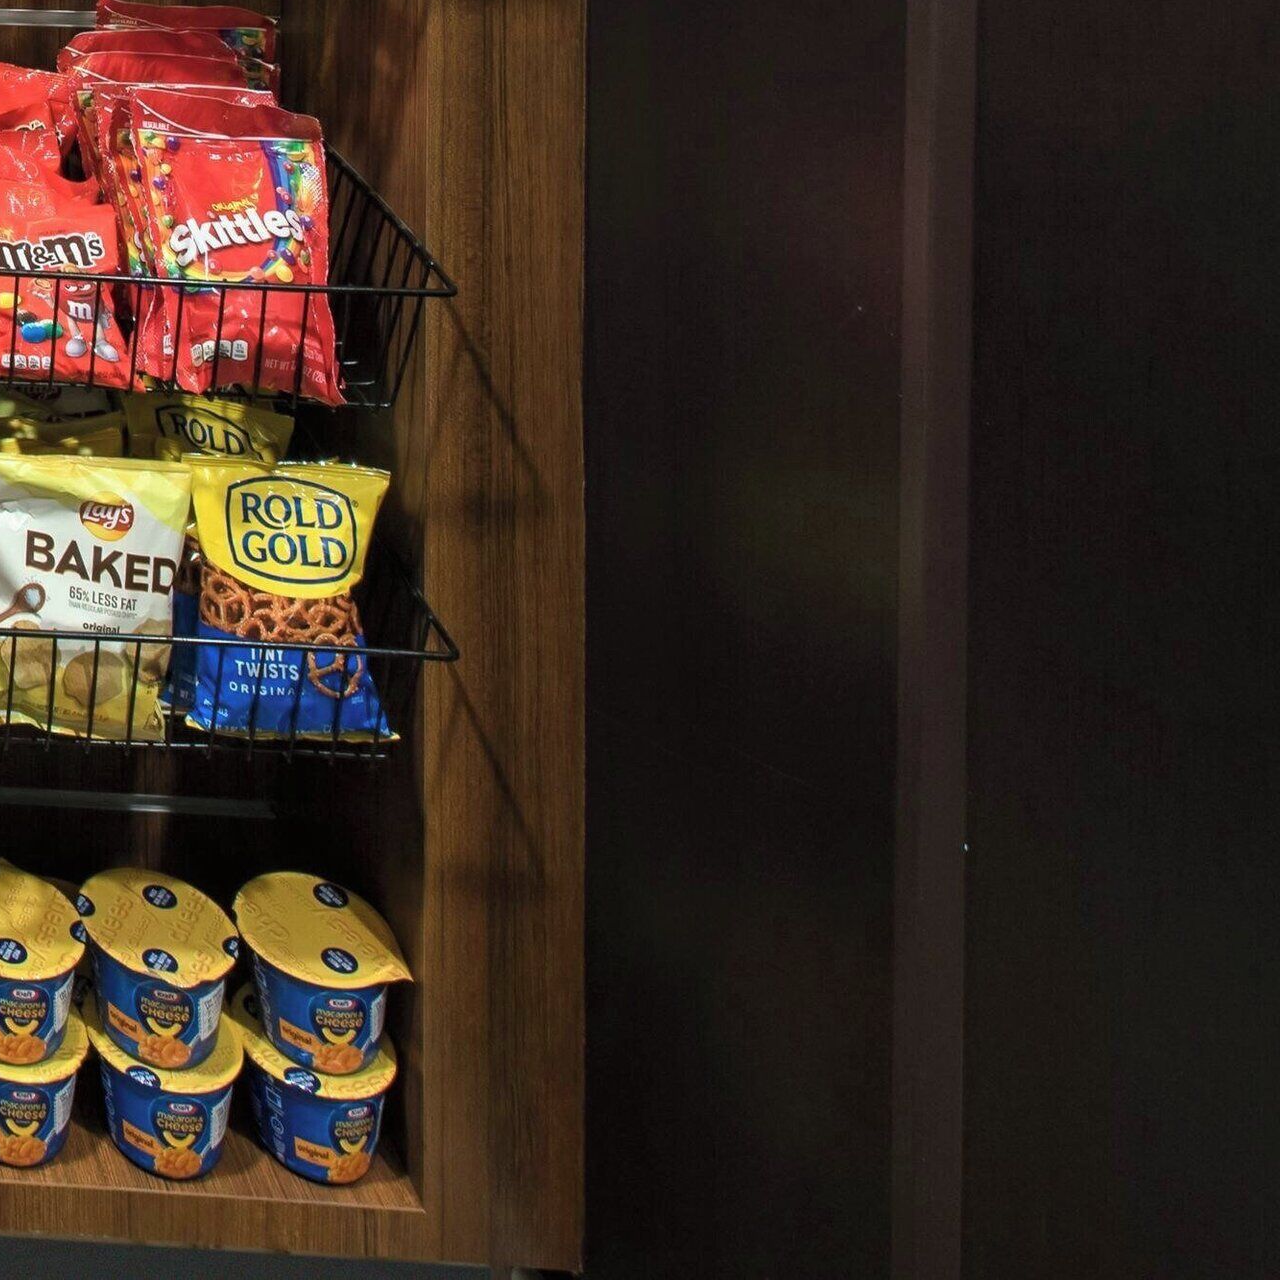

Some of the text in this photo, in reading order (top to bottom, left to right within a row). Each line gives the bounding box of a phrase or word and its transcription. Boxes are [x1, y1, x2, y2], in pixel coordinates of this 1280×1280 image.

[170, 208, 303, 267] Skittles
[174, 416, 245, 456] ROLD
[83, 499, 133, 527] Lay's
[240, 491, 344, 531] ROLD
[24, 529, 178, 596] BAKED
[240, 530, 348, 569] GOLD
[68, 585, 138, 612] 65% LESS FAT
[282, 1024, 313, 1047] original
[124, 1127, 155, 1151] original
[297, 1143, 330, 1161] original
